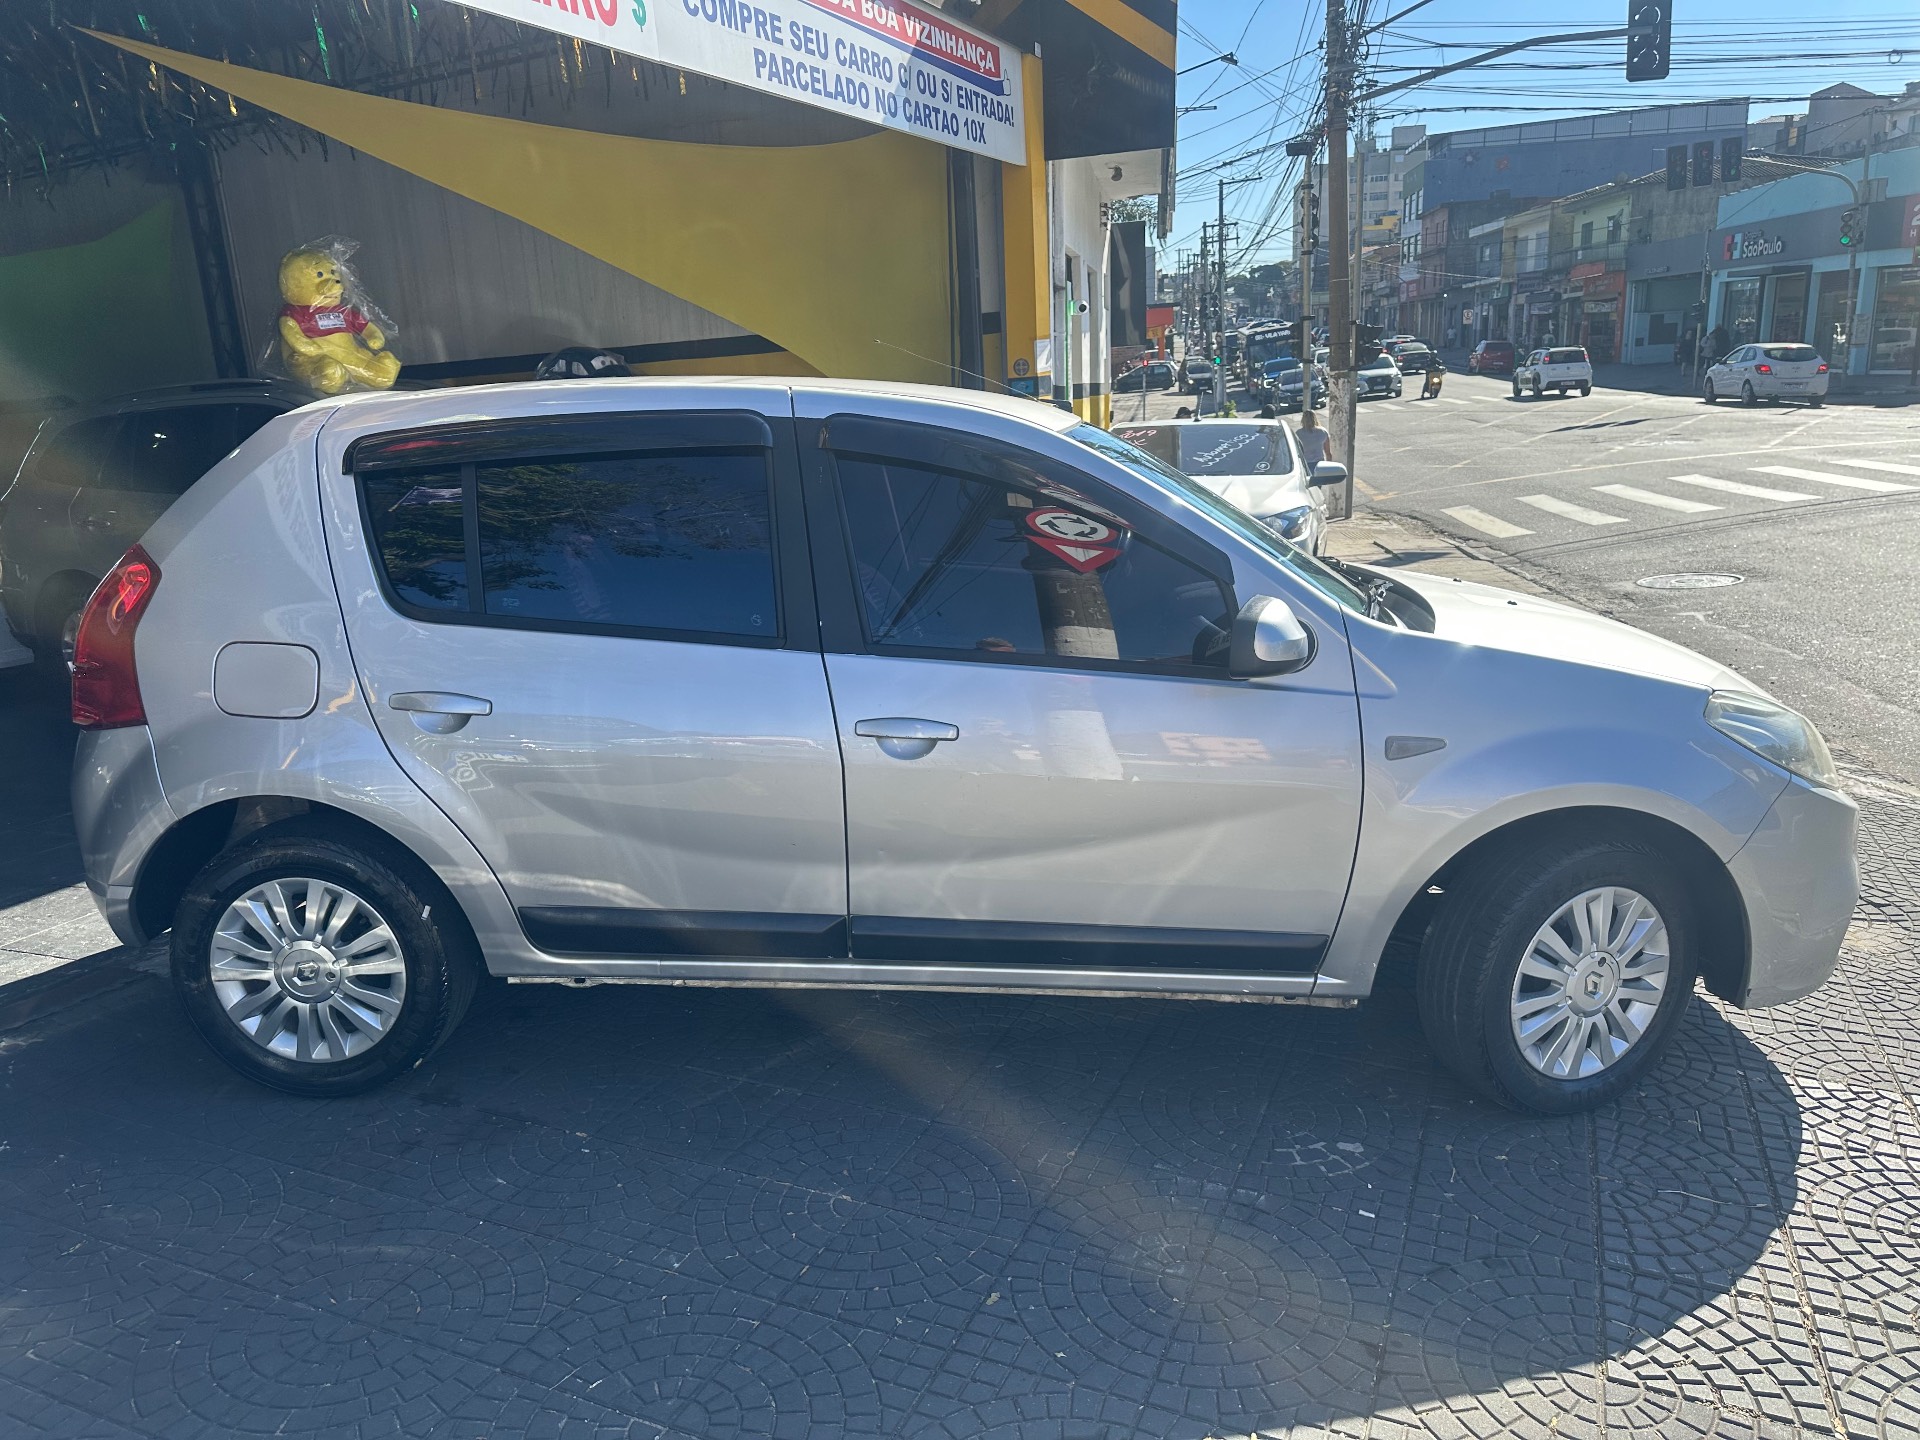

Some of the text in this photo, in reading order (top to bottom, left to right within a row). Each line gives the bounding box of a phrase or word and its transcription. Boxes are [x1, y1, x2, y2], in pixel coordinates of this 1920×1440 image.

[789, 21, 828, 60] SEU
[835, 38, 893, 83] CARRO
[899, 63, 911, 90] C/
[916, 70, 937, 98] OU
[941, 79, 952, 104] S/
[956, 84, 1014, 127] ENTRADA!
[861, 0, 899, 31] BOA
[903, 12, 995, 72] VIZINHANÇA
[753, 48, 986, 144] PARCELADO NO CARTAO 10X
